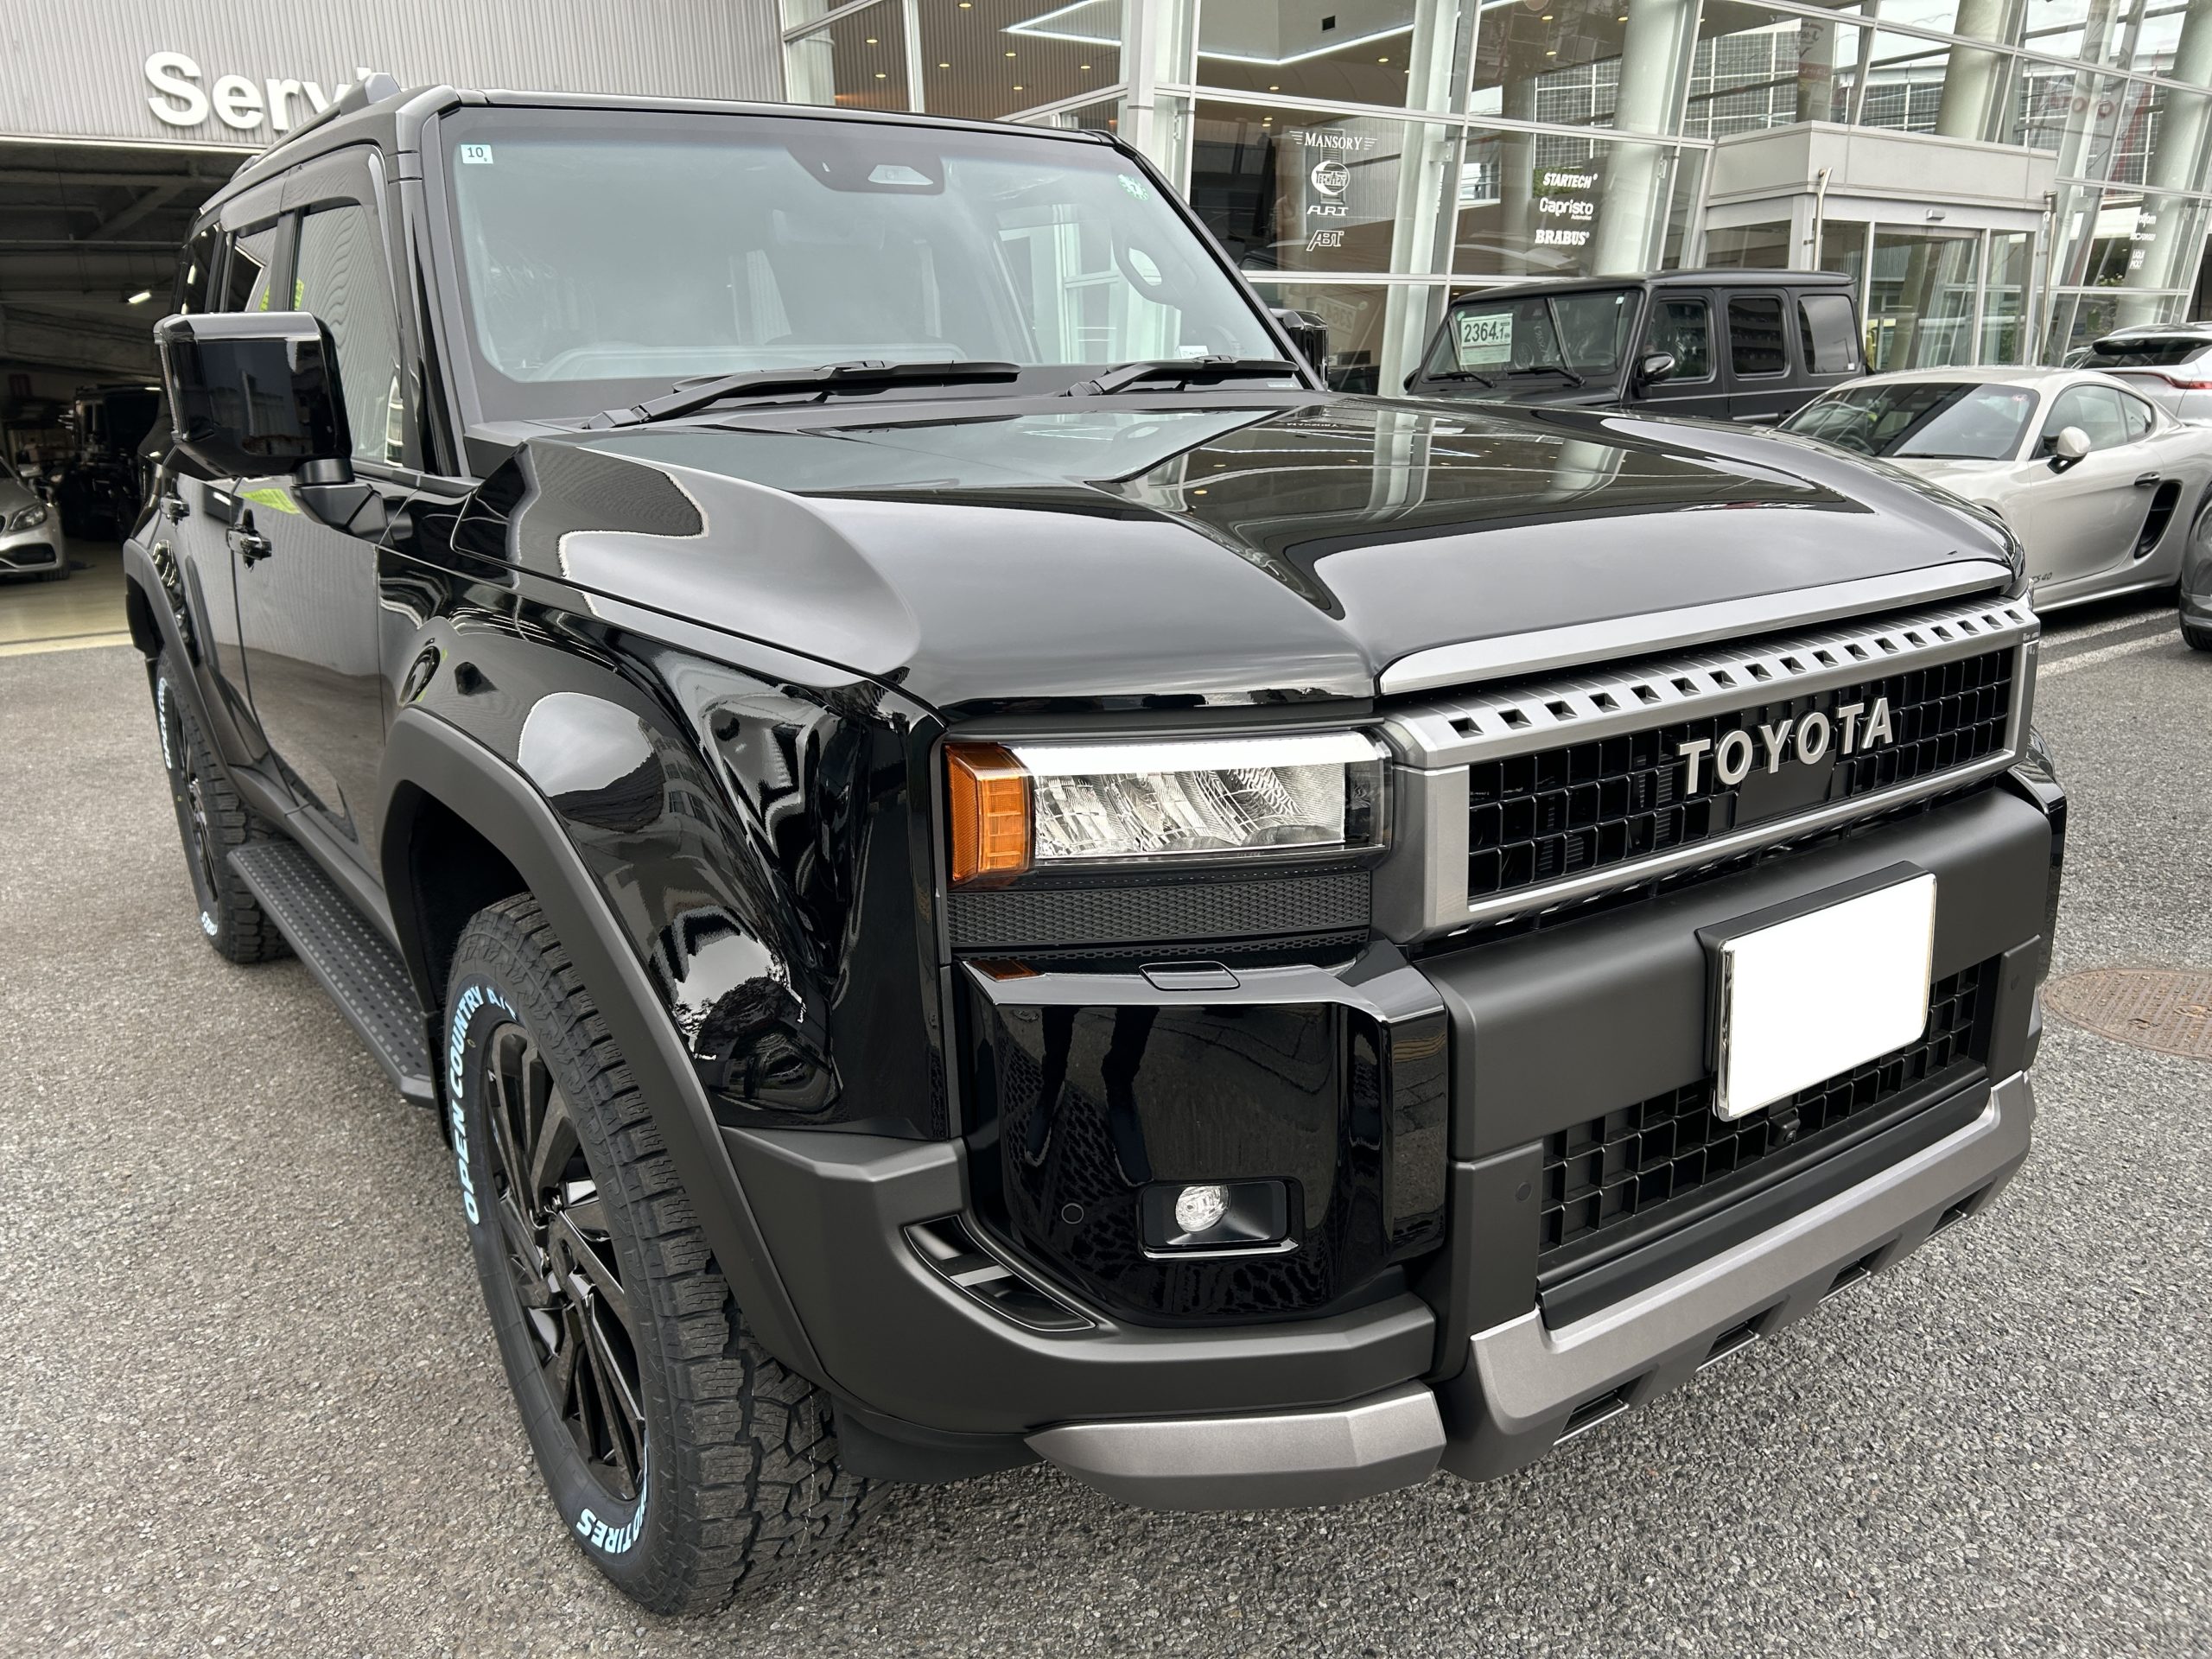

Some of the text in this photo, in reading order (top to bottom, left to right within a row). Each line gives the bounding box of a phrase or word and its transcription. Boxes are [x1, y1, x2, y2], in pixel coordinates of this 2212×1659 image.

[467, 146, 484, 158] 10
[1304, 132, 1363, 150] MANSORY
[1542, 172, 1592, 188] STARTECH
[1539, 196, 1594, 217] Capristo
[1306, 229, 1345, 252] ABT
[1535, 229, 1586, 245] BRABUS
[1464, 321, 1504, 343] 2364.1
[1676, 696, 1894, 795] TOYOTA
[449, 985, 484, 1099] COUNTRY
[452, 1098, 480, 1225] OPEN
[576, 1508, 632, 1554] TIRES
